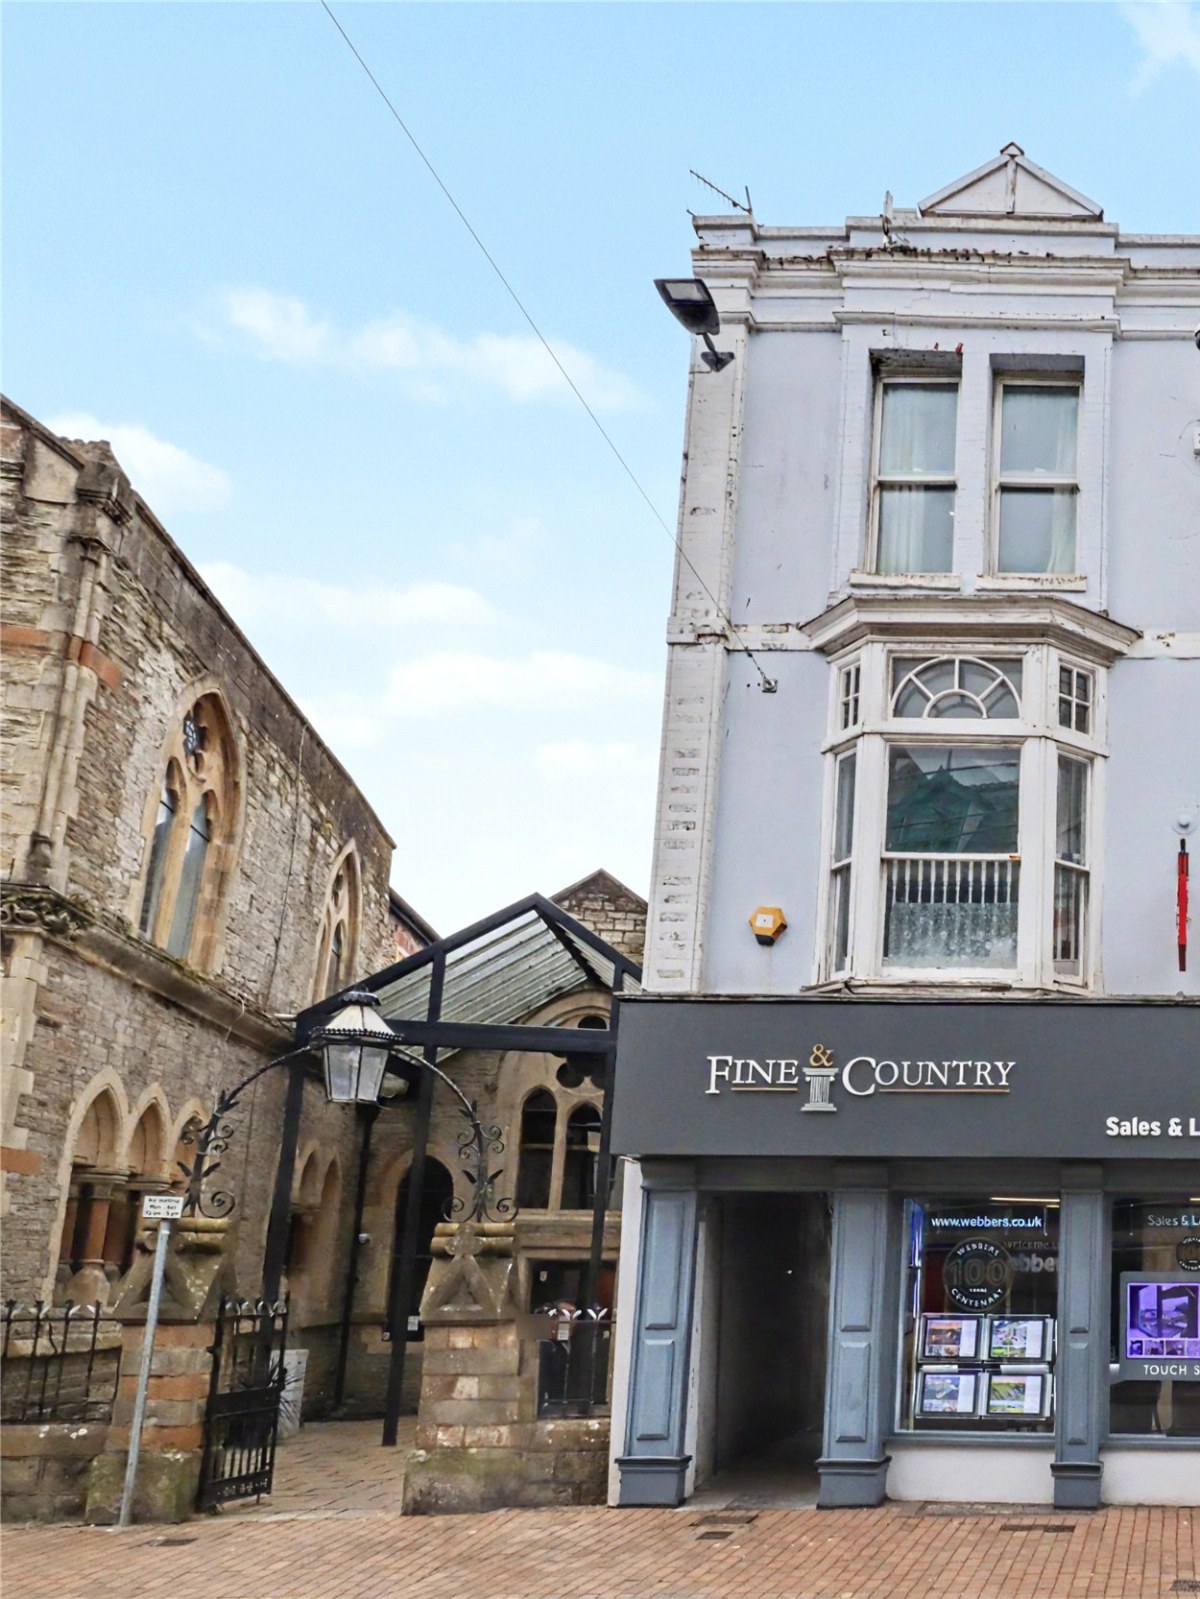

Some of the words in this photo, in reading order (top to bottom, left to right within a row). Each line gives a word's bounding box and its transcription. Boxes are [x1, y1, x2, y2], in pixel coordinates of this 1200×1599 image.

[809, 1043, 835, 1067] &
[1105, 1117, 1161, 1138] Sales
[1168, 1117, 1183, 1138] &
[931, 1215, 1043, 1228] www.webbers.co.uk
[1147, 1214, 1179, 1227] Sales
[1143, 1364, 1187, 1376] TOUCH
